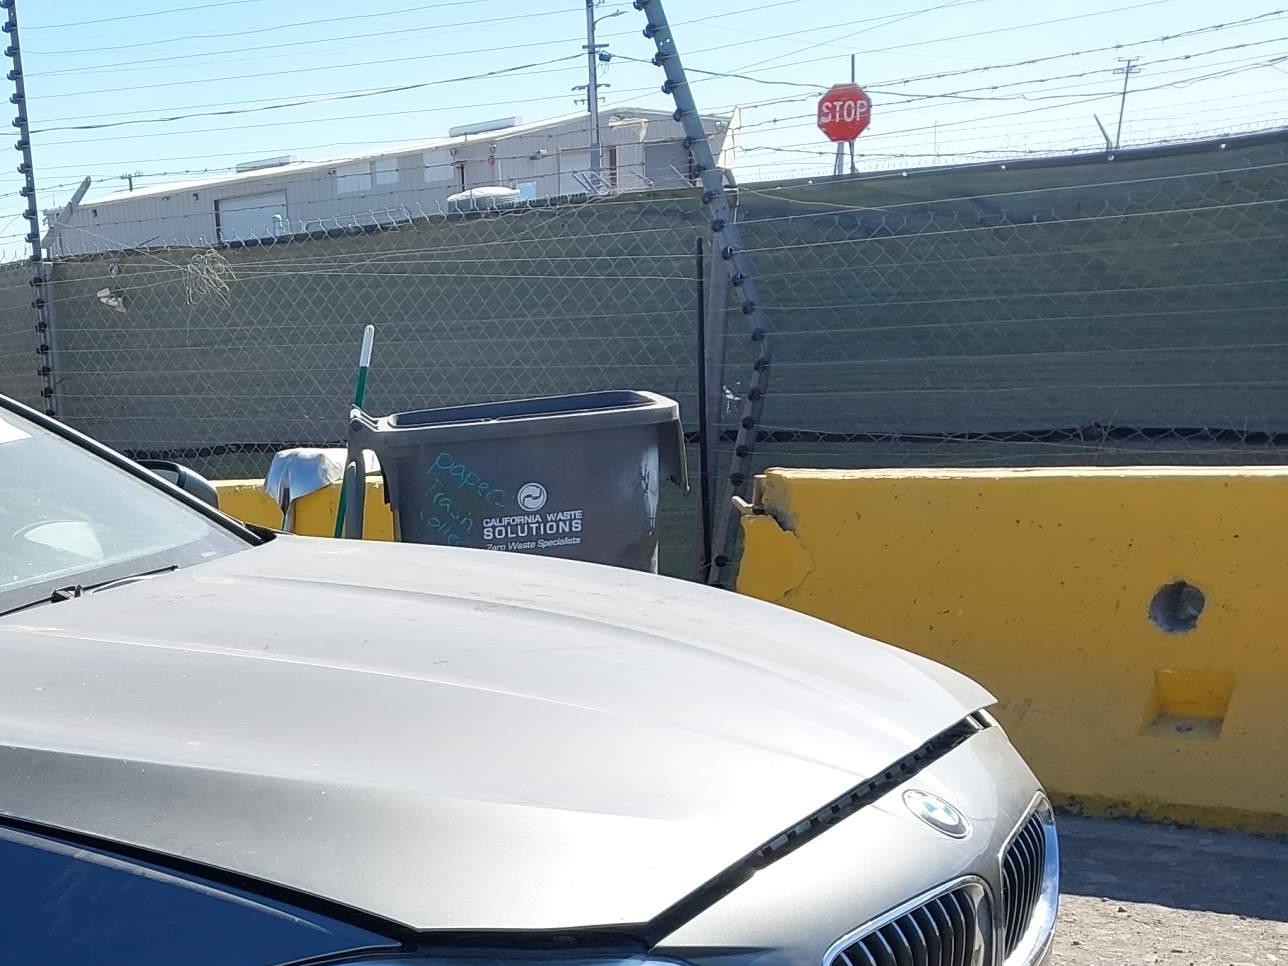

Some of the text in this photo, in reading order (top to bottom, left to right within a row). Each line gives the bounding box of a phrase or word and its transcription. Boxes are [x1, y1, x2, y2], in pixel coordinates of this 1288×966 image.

[820, 100, 868, 123] STOP
[482, 510, 584, 527] CALIFORNIA WASTE
[483, 520, 583, 540] SOLUTIONS
[508, 540, 536, 550] Waste
[537, 536, 582, 549] Specialists
